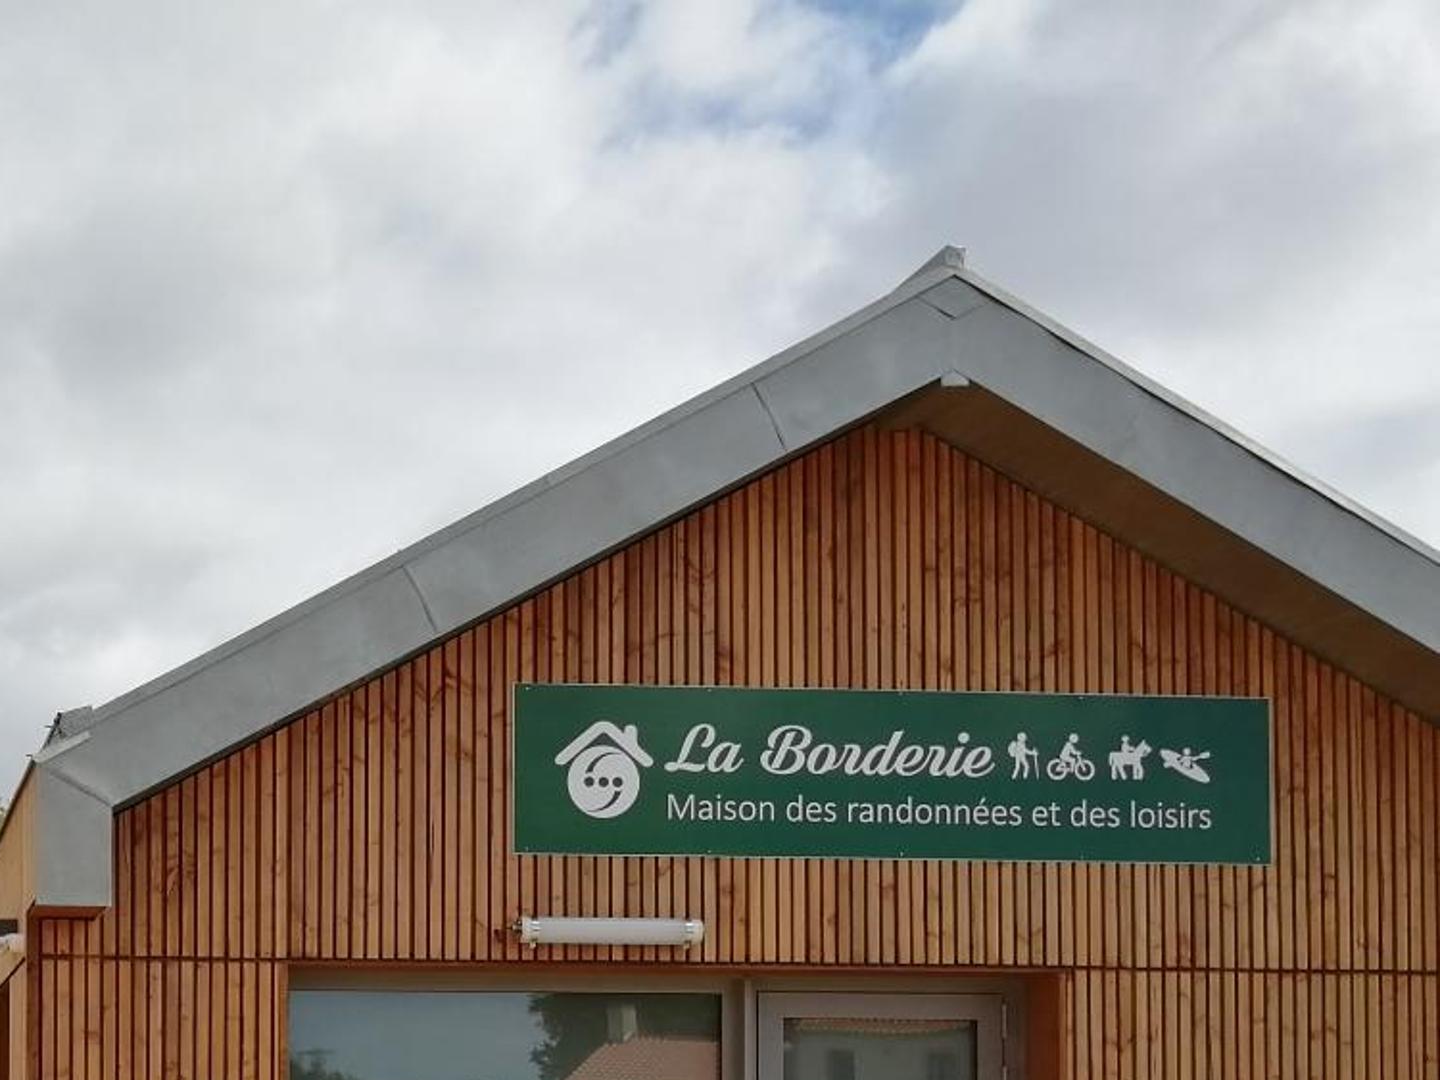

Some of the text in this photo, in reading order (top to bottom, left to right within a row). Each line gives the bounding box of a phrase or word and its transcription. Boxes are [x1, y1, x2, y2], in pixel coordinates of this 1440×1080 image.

[663, 723, 996, 779] La Borderie
[667, 793, 1212, 830] Maison des randonnées et des loisirs
